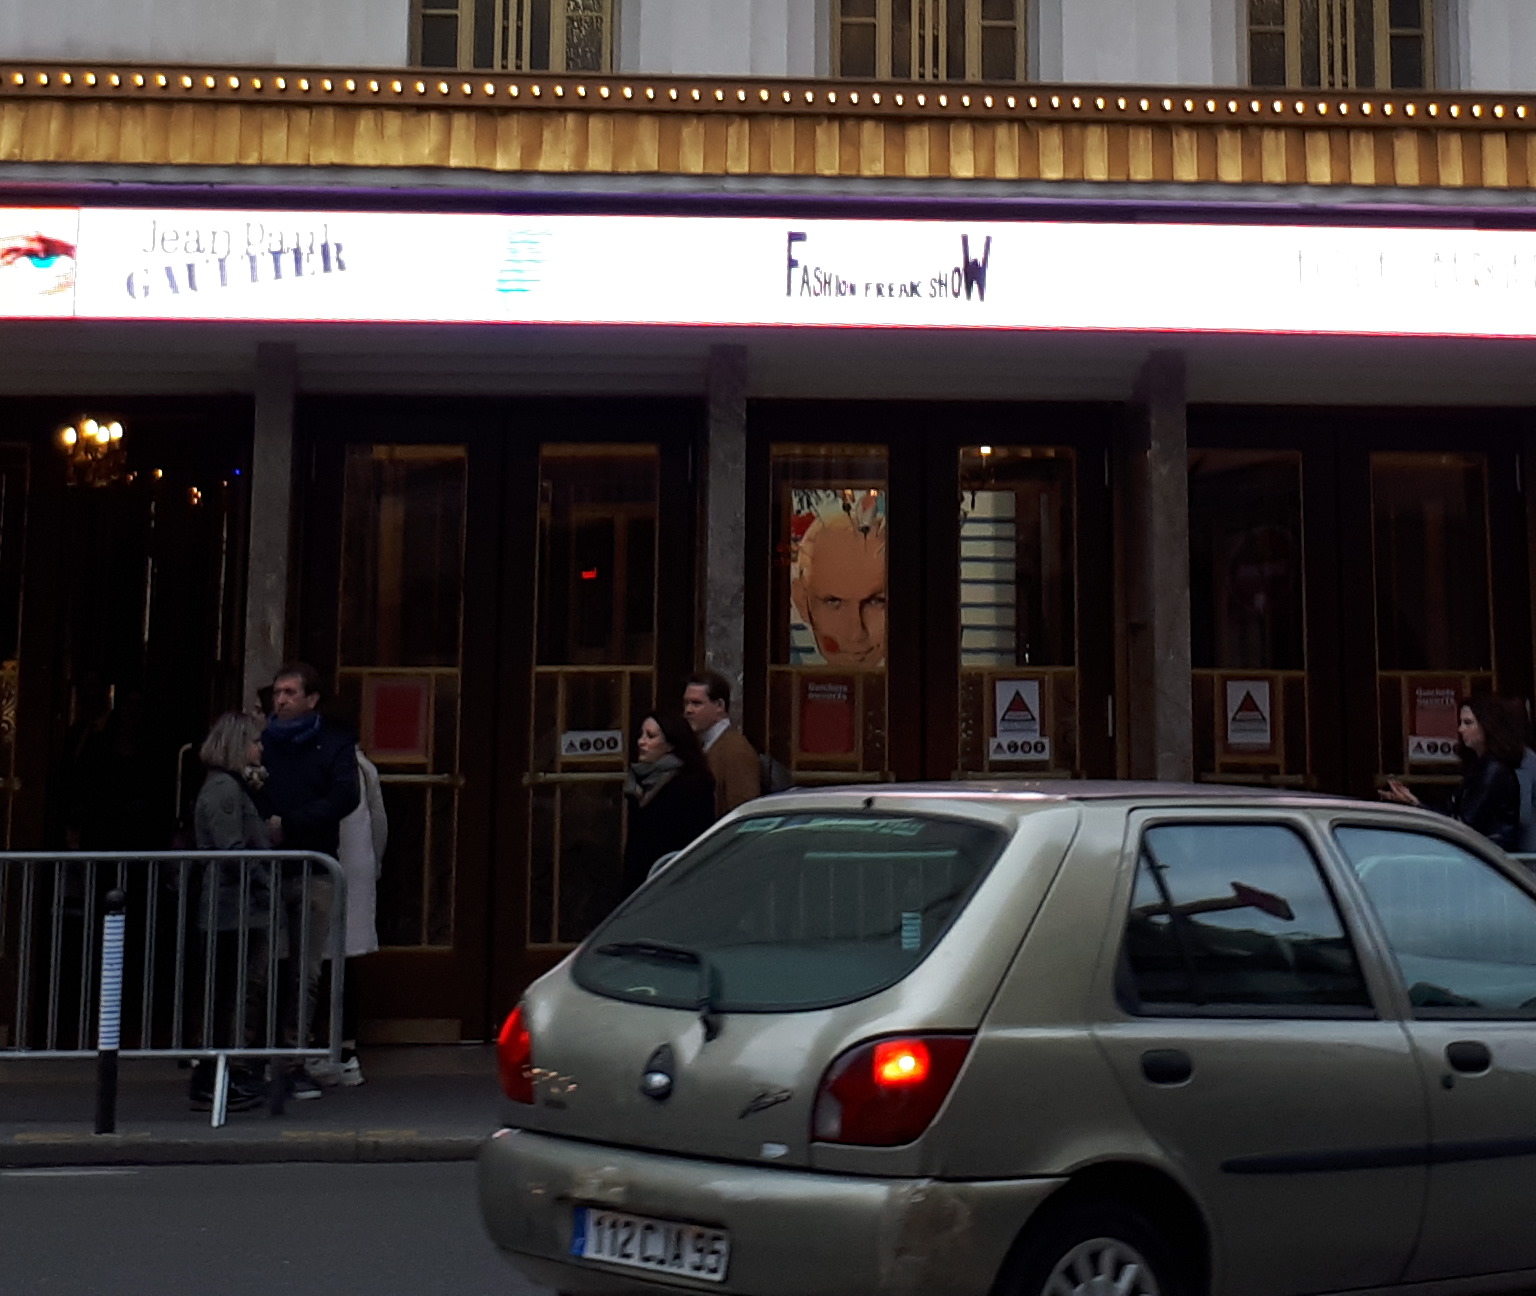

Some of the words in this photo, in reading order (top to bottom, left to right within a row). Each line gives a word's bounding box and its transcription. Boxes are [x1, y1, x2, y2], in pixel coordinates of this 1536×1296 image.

[142, 219, 230, 256] Jean
[244, 221, 330, 257] Paul
[125, 241, 347, 300] GAULTIER
[785, 230, 857, 298] FASHION
[864, 281, 923, 298] FREAK
[928, 233, 993, 303] SHOW
[595, 1218, 633, 1259] 112
